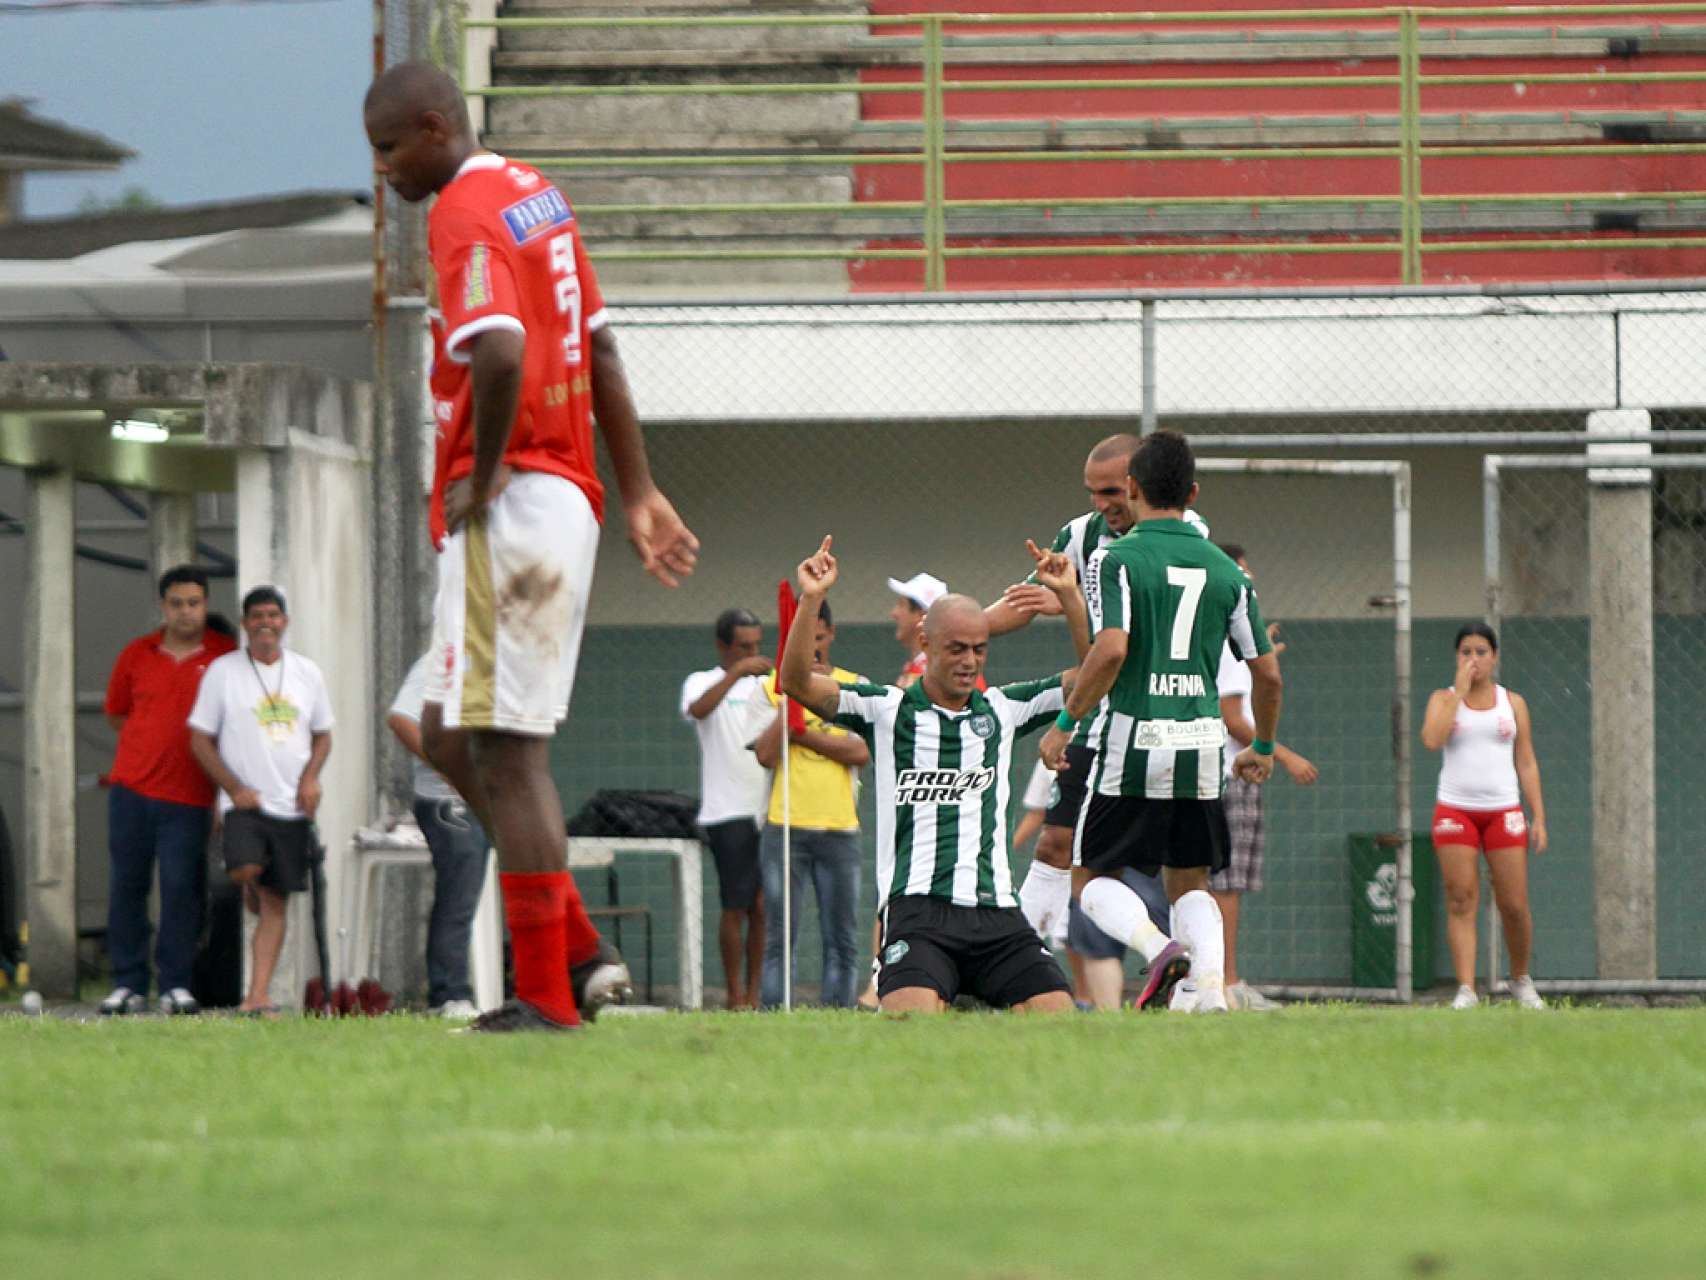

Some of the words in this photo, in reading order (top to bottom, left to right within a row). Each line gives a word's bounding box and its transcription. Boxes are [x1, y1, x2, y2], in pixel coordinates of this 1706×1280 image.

[1166, 566, 1207, 660] 7
[899, 771, 957, 786] PRO
[897, 788, 966, 803] TORK
